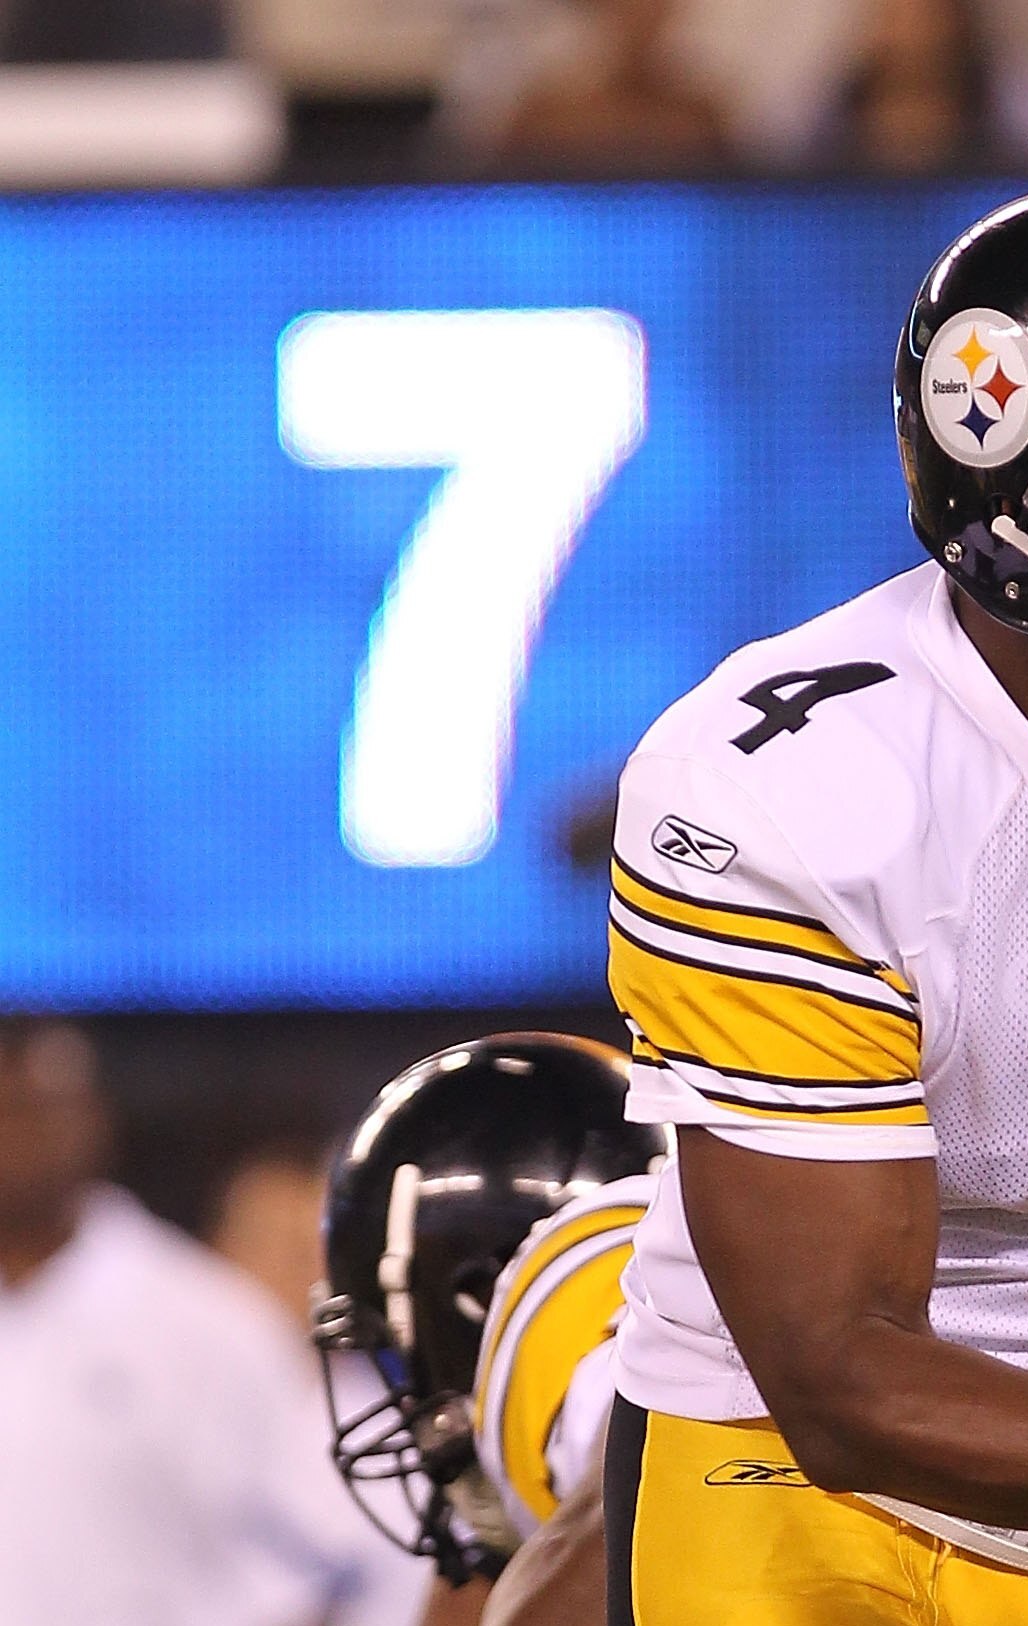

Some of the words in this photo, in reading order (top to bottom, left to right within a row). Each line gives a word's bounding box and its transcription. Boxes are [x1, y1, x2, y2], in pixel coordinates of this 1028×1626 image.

[932, 378, 968, 394] Steelers
[277, 308, 648, 867] 7
[728, 661, 898, 755] 4
